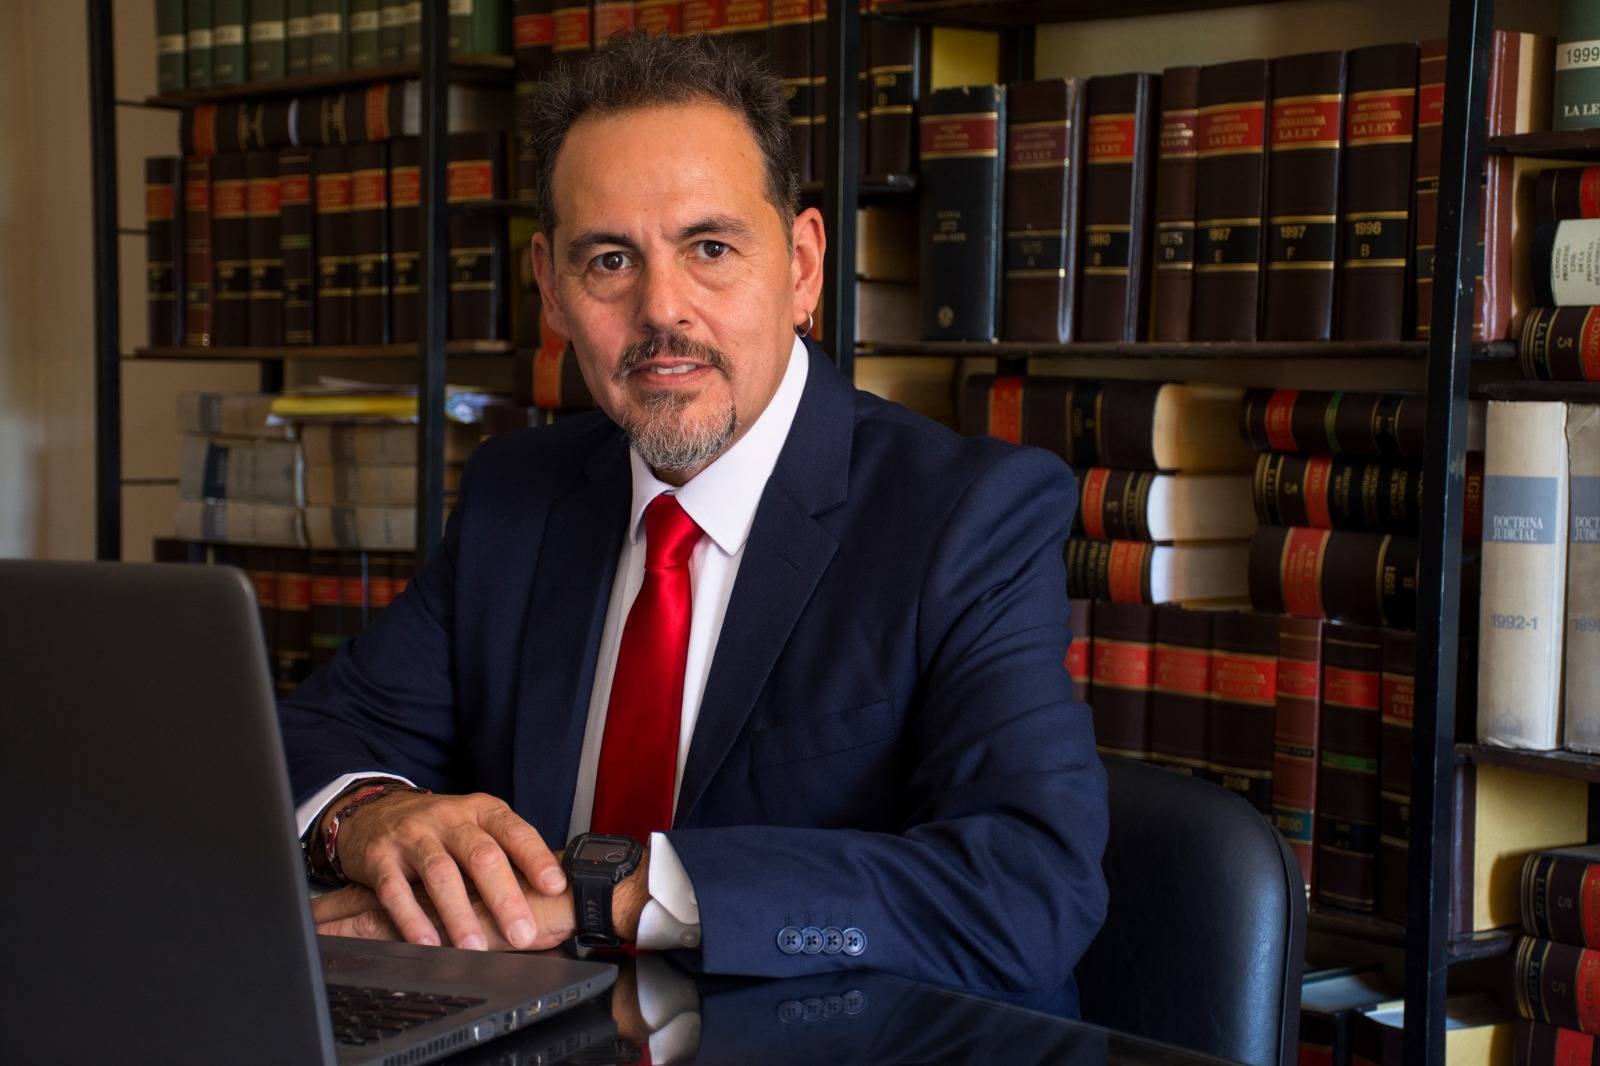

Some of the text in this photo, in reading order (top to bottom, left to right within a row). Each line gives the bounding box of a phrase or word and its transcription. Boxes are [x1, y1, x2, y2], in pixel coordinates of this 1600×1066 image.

[1566, 47, 1600, 64] 1999
[1563, 104, 1580, 117] LA
[1371, 122, 1397, 134] LEY
[1280, 225, 1307, 240] 1997
[1493, 515, 1544, 529] DOCTRINA
[1492, 528, 1538, 542] JUDICIAL
[1491, 613, 1538, 630] 1992-1
